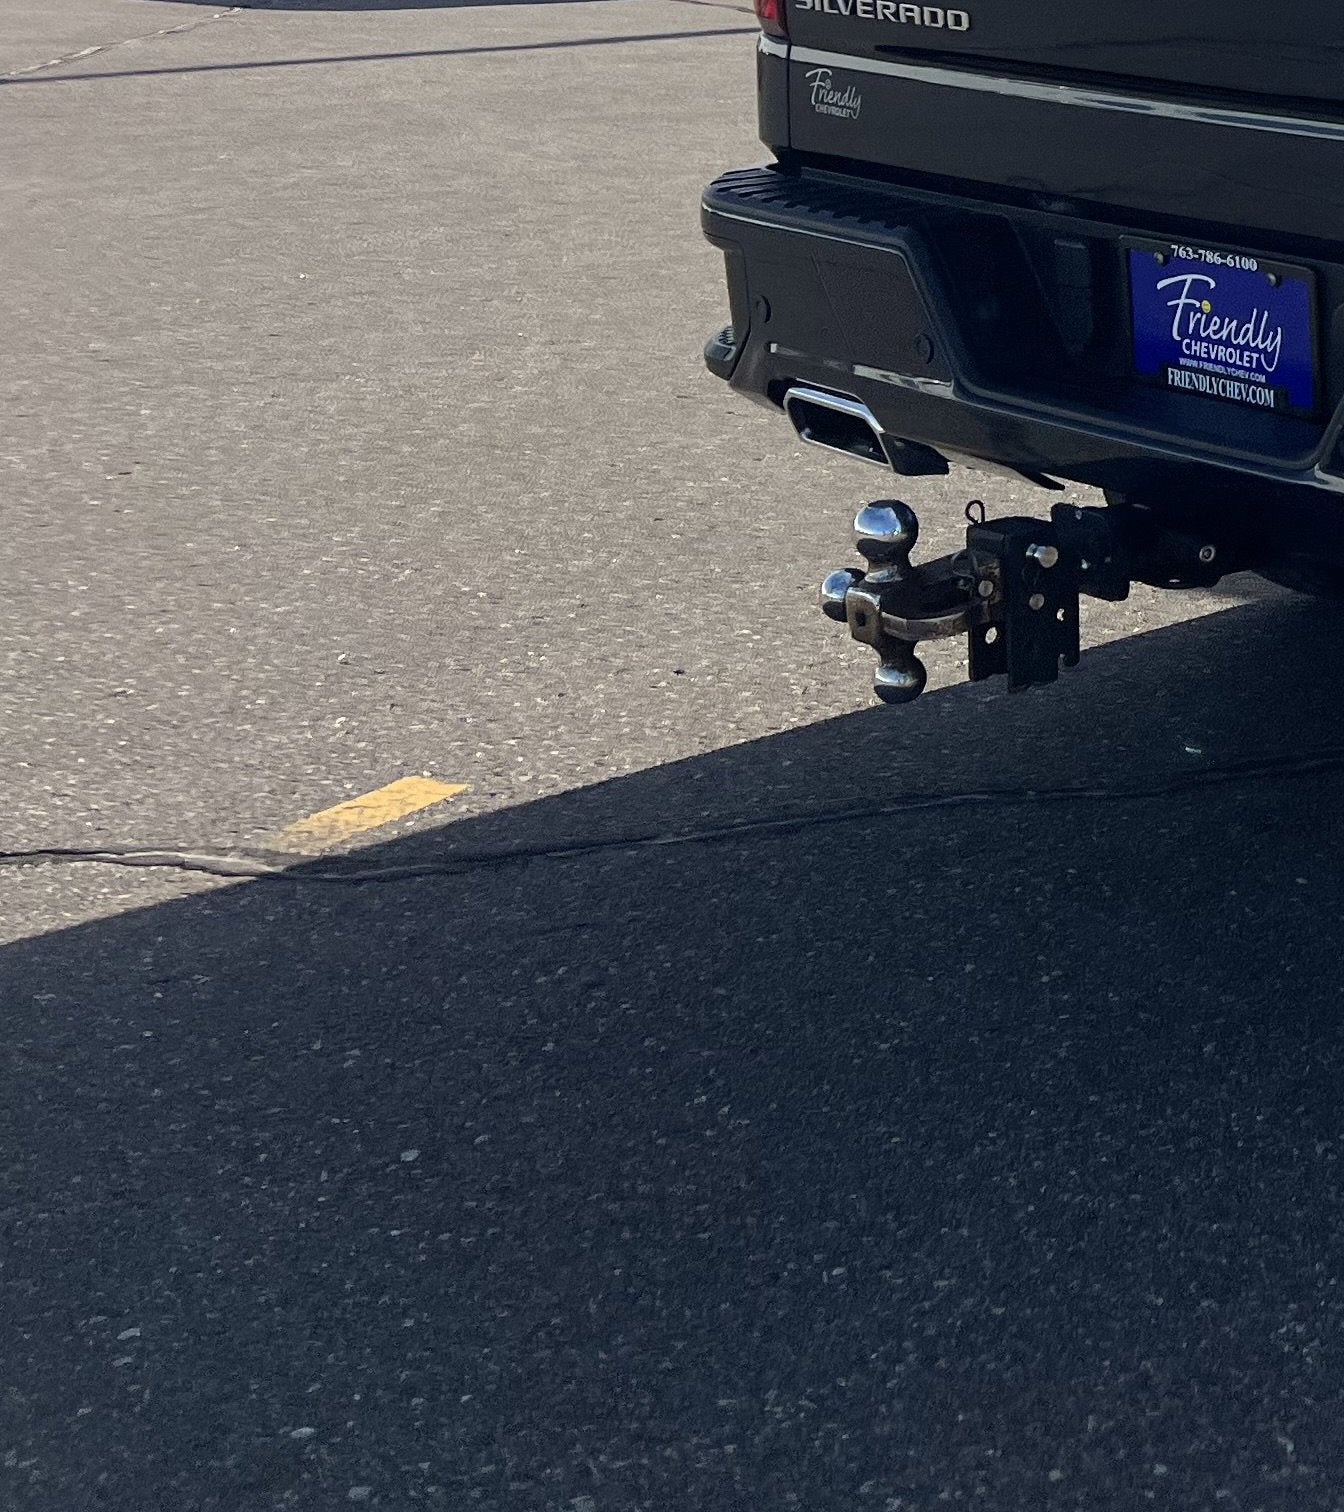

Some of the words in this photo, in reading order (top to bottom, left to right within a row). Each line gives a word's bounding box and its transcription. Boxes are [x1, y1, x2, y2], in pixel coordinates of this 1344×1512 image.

[805, 68, 862, 120] Friendly
[815, 103, 852, 118] CHEVROLET
[1170, 244, 1258, 272] 763-786-6100
[1156, 273, 1282, 372] Friendly
[1181, 338, 1260, 369] CHEVROLET
[1167, 367, 1275, 408] FRIENDLYCHEV.COM
